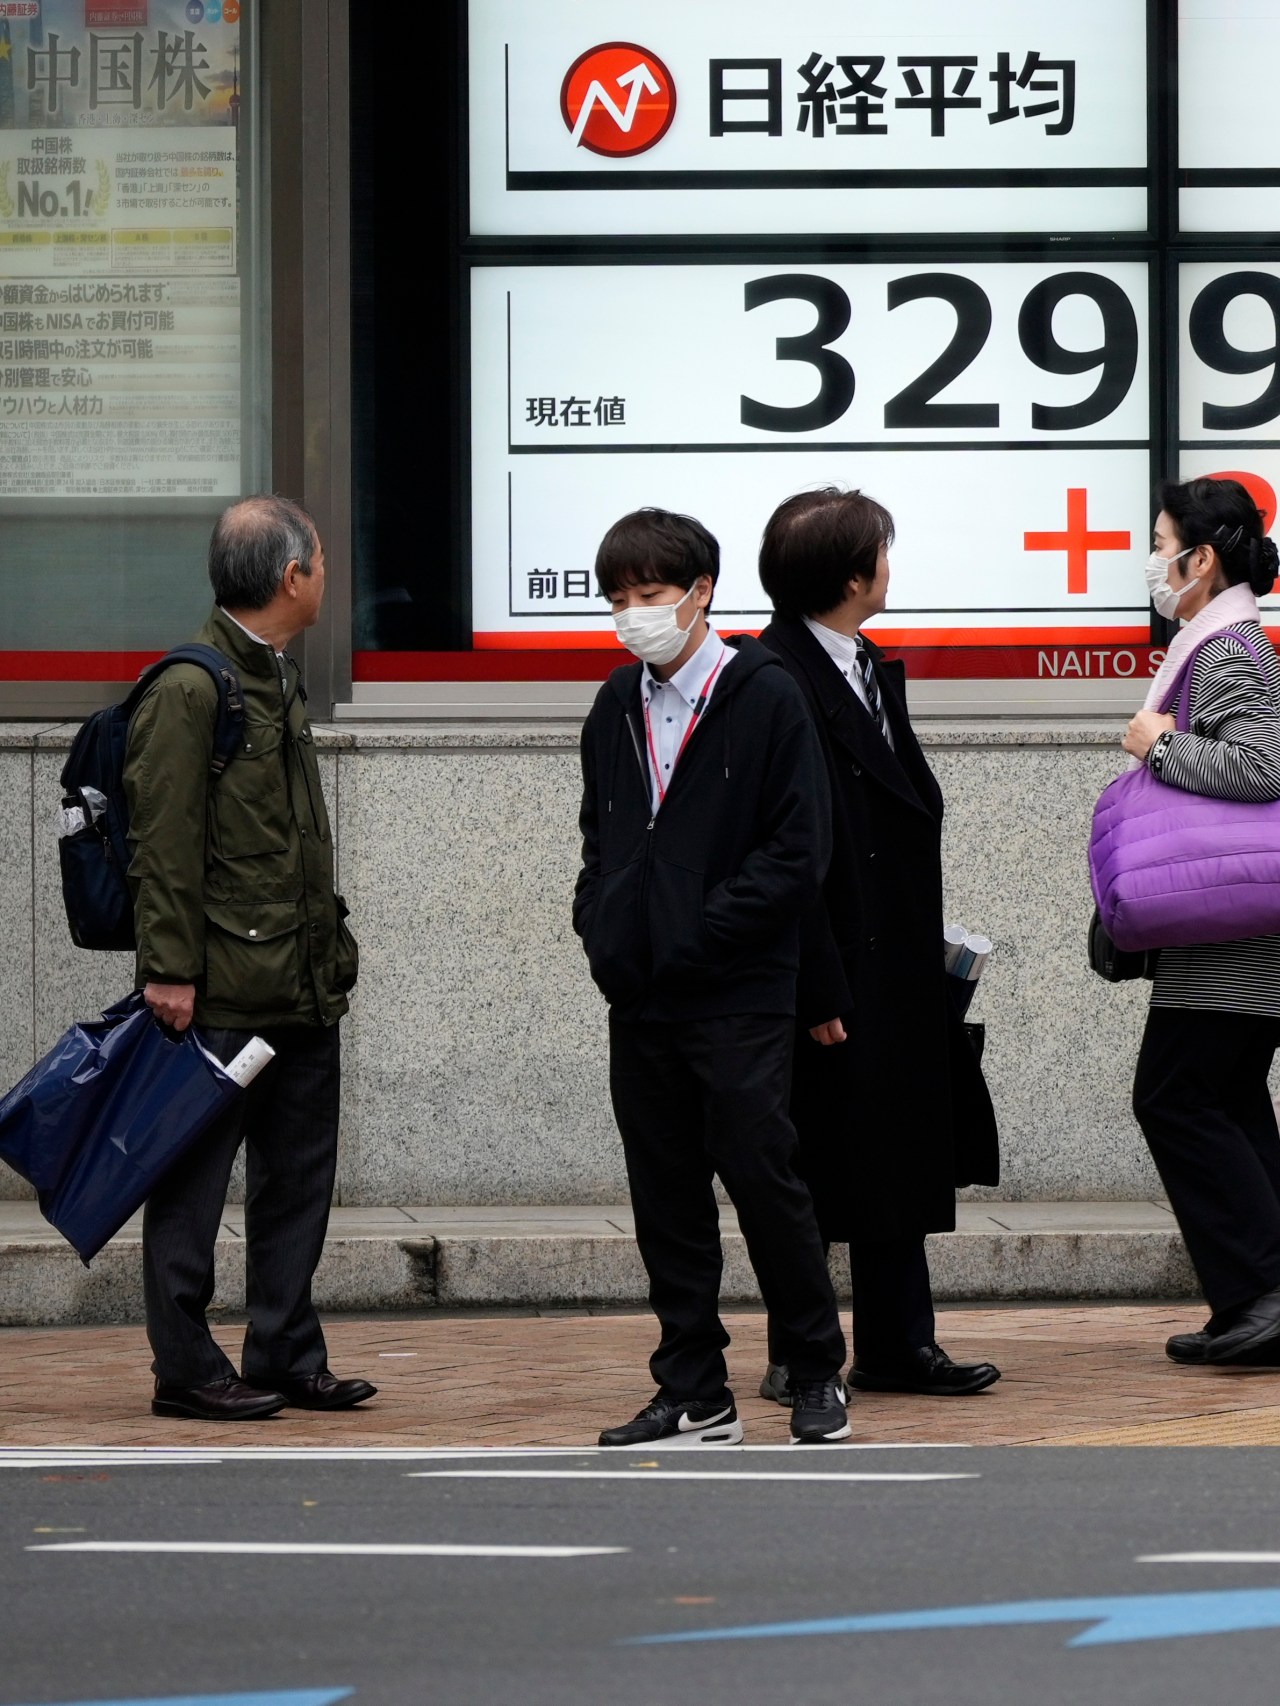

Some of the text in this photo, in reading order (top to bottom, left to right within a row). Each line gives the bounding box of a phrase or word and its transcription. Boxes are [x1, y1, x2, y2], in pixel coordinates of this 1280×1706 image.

[27, 30, 211, 113] 中国株
[708, 51, 1077, 137] 日経平均
[31, 136, 73, 155] 中国株
[17, 157, 86, 176] 取扱銘柄数
[17, 179, 94, 217] No.1!
[0, 339, 153, 360] 引時間中の注文が可能
[0, 395, 103, 415] ウハウと人材力
[525, 396, 626, 427] 現在値
[1038, 651, 1136, 677] NAITO
